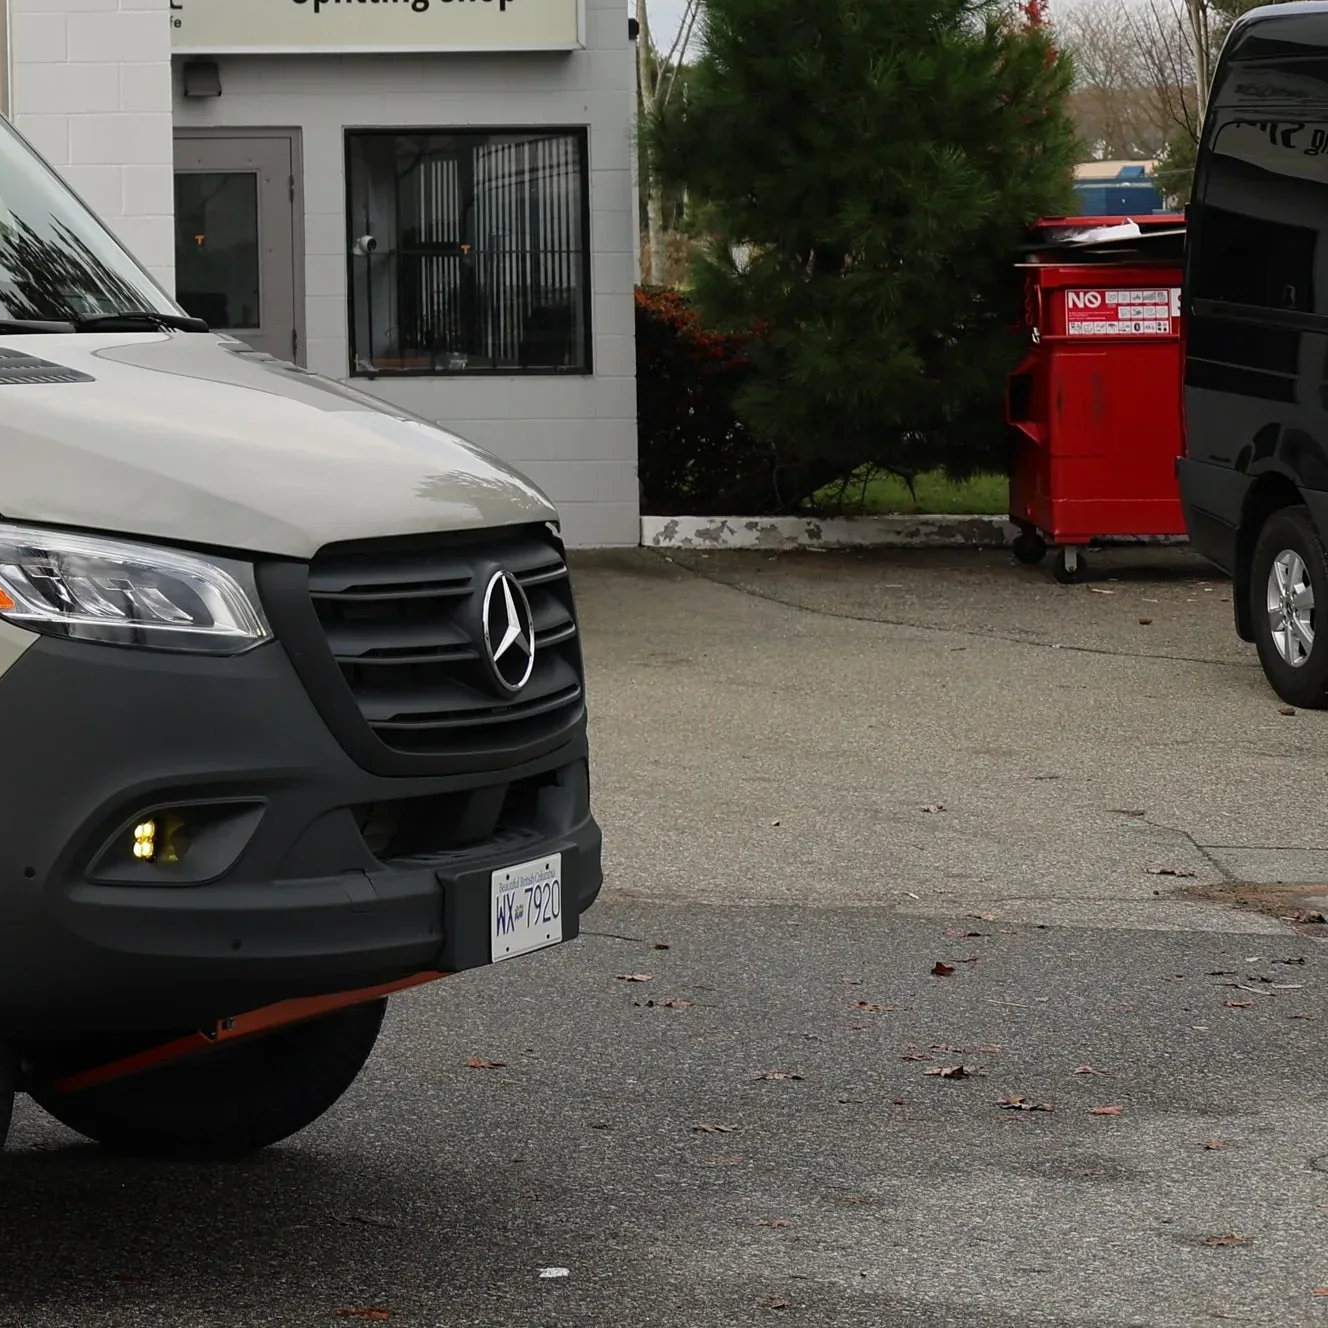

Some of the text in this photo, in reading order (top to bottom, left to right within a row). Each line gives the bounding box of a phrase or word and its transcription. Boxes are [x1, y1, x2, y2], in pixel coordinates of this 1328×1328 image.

[1068, 291, 1102, 309] NO
[496, 879, 560, 938] WX 7920
